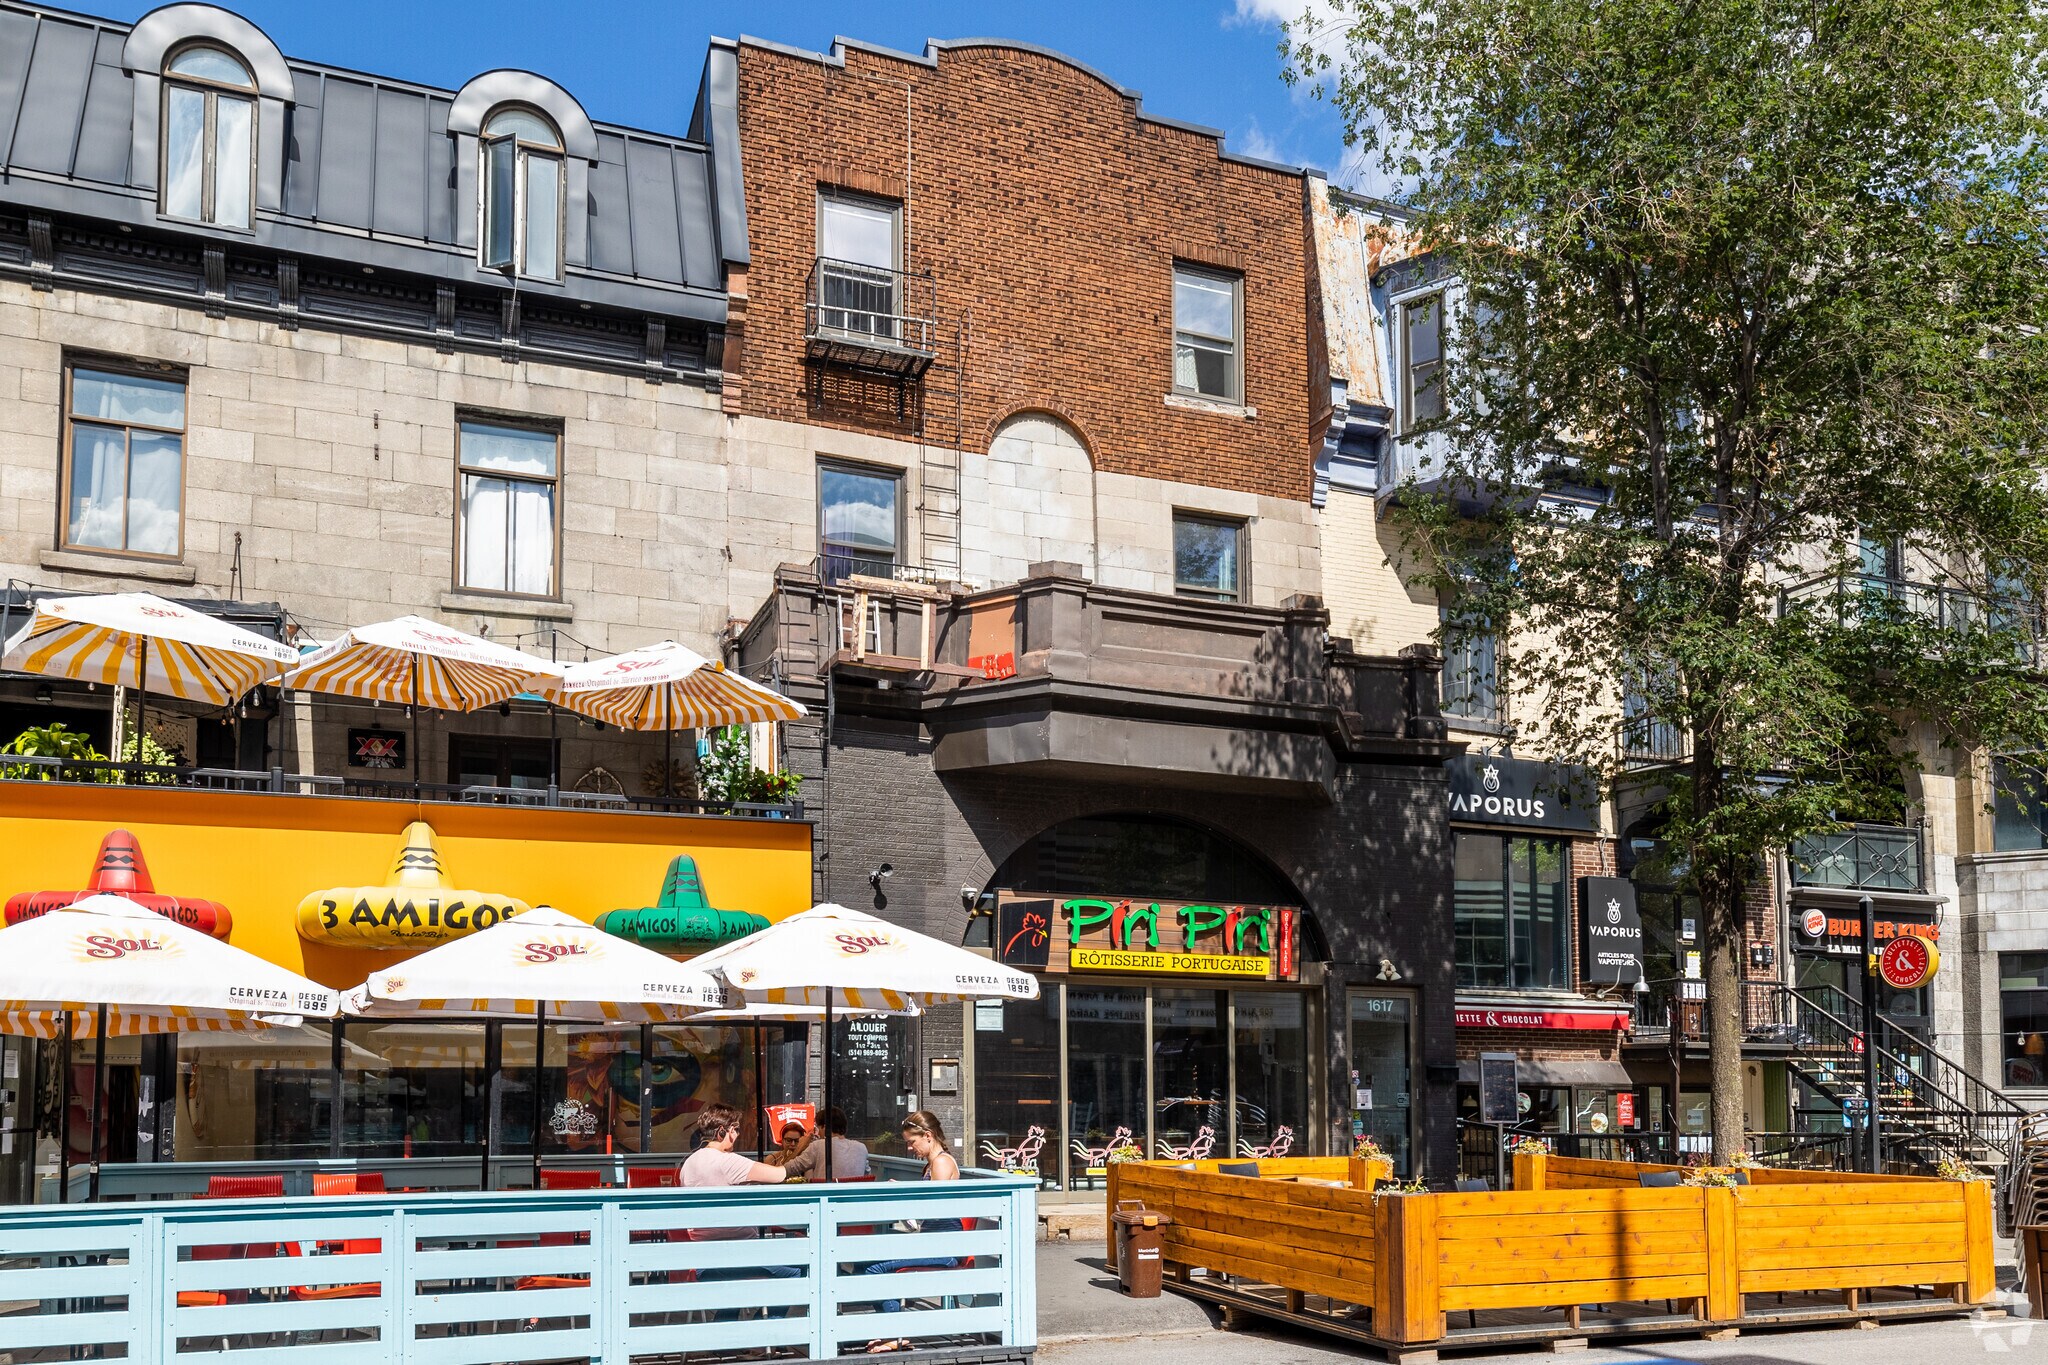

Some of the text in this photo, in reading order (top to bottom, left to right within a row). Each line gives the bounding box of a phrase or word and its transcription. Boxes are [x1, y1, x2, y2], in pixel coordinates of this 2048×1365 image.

[232, 639, 268, 650] CERVEZA
[356, 737, 398, 757] XX
[1448, 793, 1546, 819] APORUS
[322, 900, 339, 929] 3
[621, 917, 676, 933] 3 AMIGOS
[721, 920, 728, 936] 3
[1063, 899, 1272, 952] Piri Piri
[1590, 925, 1641, 938] VAPORUS
[1807, 920, 1824, 930] KING
[1827, 917, 1895, 939] BURER
[1885, 940, 1915, 960] JULIETTE
[1078, 950, 1264, 973] RÔTISSERIE PORTUGAISE
[955, 975, 1000, 984] CERVEZA
[1006, 977, 1029, 985] DESDE
[230, 987, 288, 1000] CERVEZA
[643, 983, 693, 994] CERVEZA
[702, 986, 729, 995] DESDE
[1007, 984, 1030, 993] 1899
[298, 992, 329, 1002] DESDE
[298, 1000, 327, 1012] 1899
[1366, 999, 1394, 1012] 1617
[1485, 1010, 1500, 1027] &
[1502, 1015, 1543, 1025] CHOCOLAT
[857, 1022, 887, 1032] LOUER
